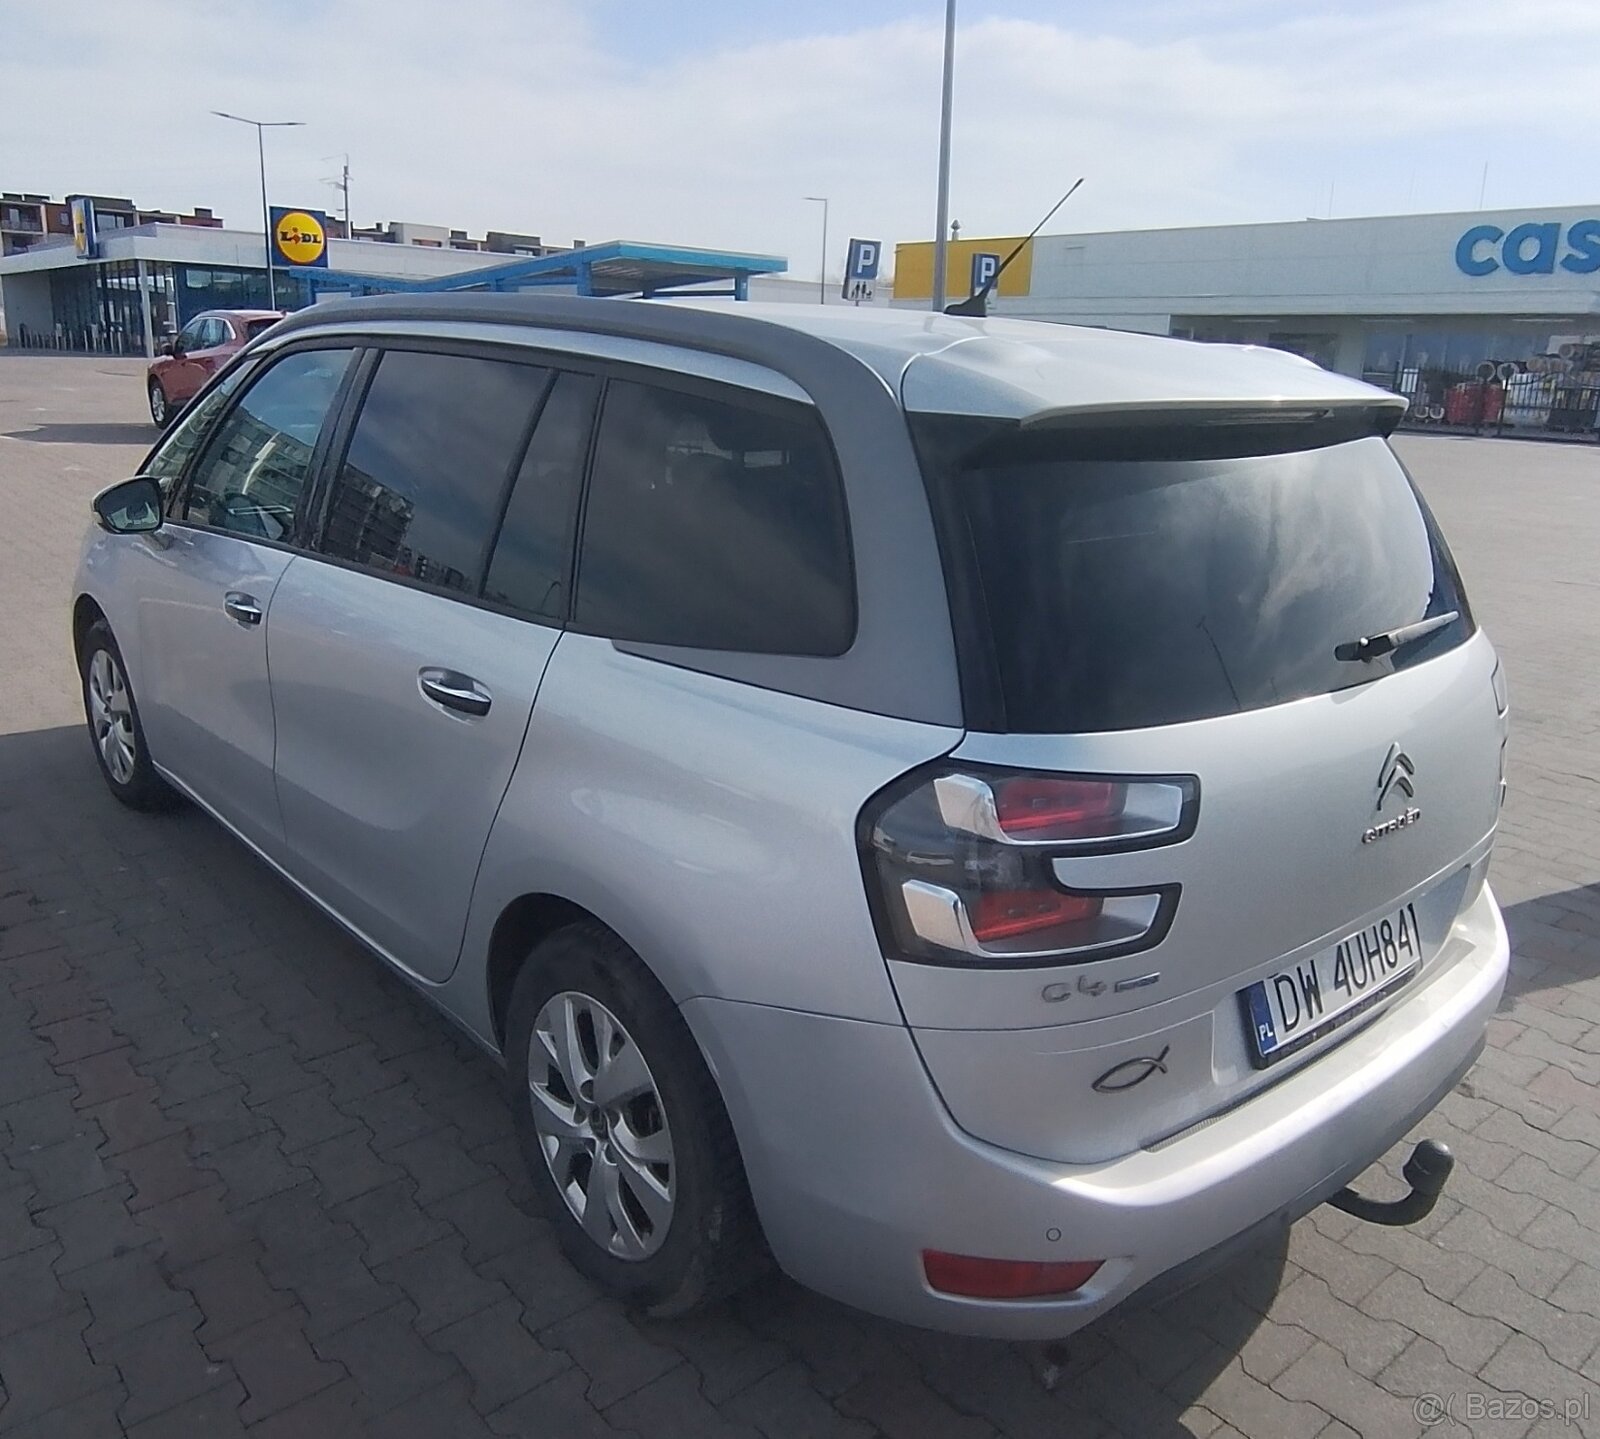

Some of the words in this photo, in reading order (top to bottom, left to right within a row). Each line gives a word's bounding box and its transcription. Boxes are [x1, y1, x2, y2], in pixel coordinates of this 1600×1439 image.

[857, 244, 876, 274] P
[1455, 219, 1600, 276] cas
[980, 257, 996, 283] P
[1273, 959, 1323, 1033] DW
[1334, 908, 1414, 997] 4UH84
[1258, 1022, 1274, 1042] PL
